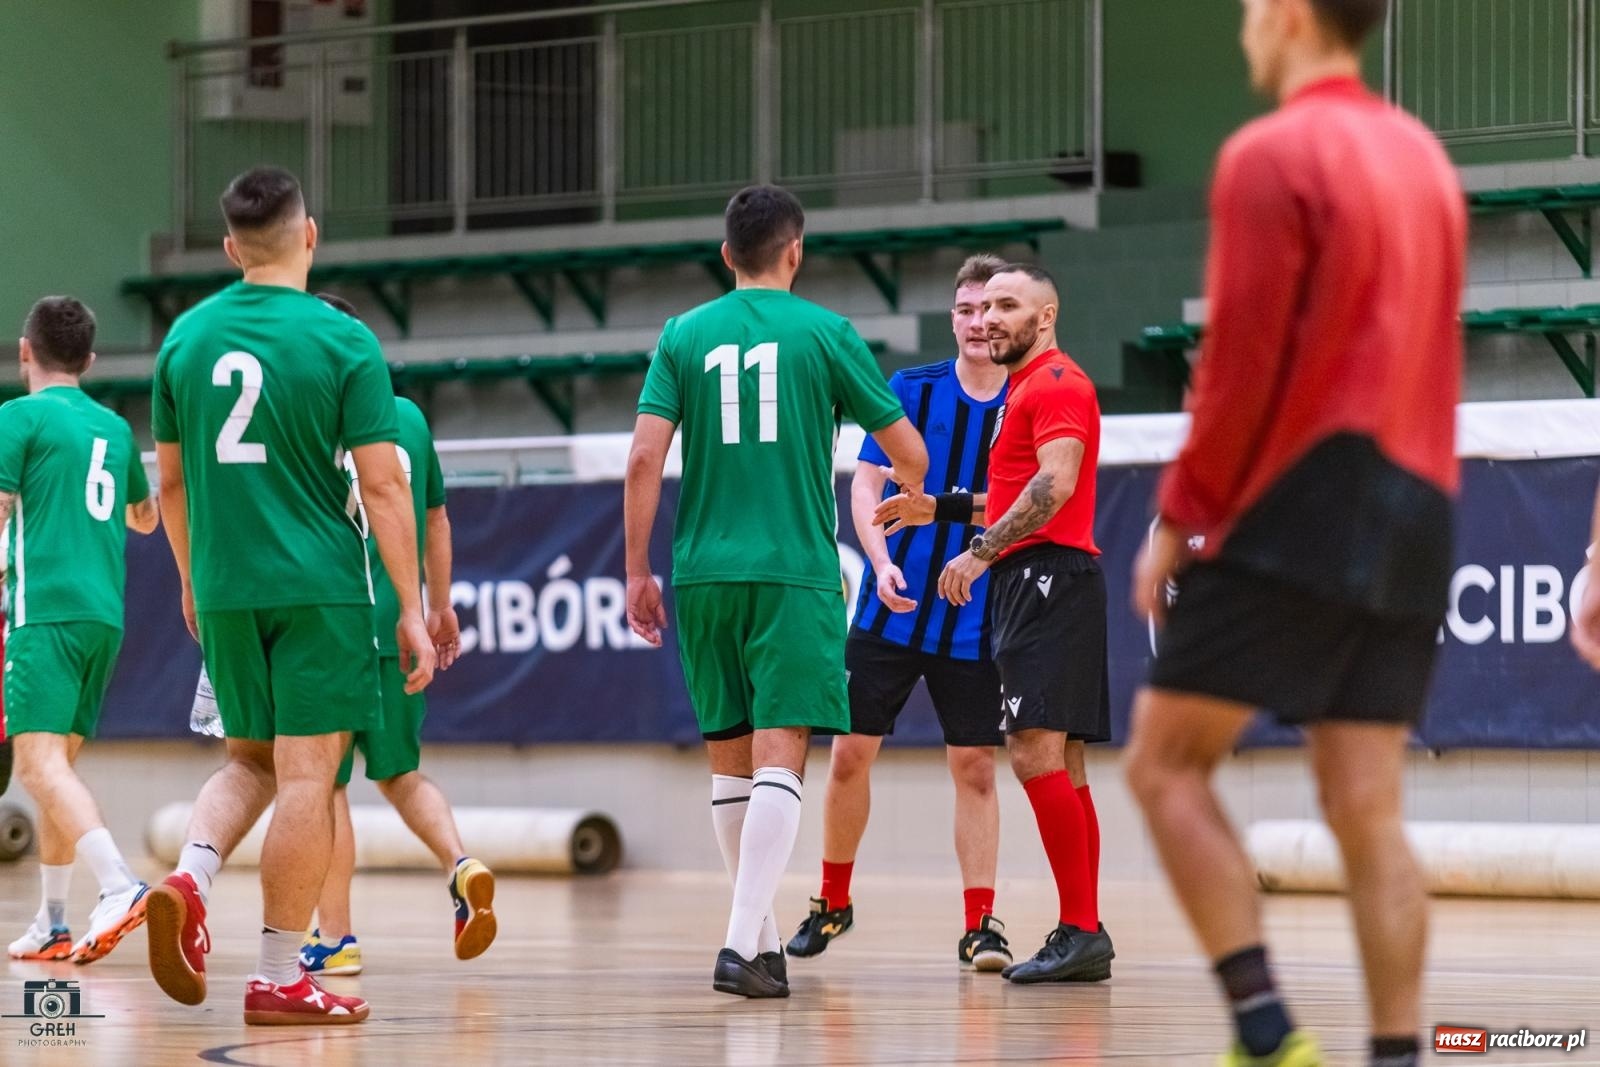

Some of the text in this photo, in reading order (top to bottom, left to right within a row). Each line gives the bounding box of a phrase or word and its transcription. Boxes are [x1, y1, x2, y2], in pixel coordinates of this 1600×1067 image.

[211, 350, 268, 464] 2
[704, 342, 779, 445] 11
[85, 437, 116, 522] 6
[422, 554, 664, 653] CIBÓR
